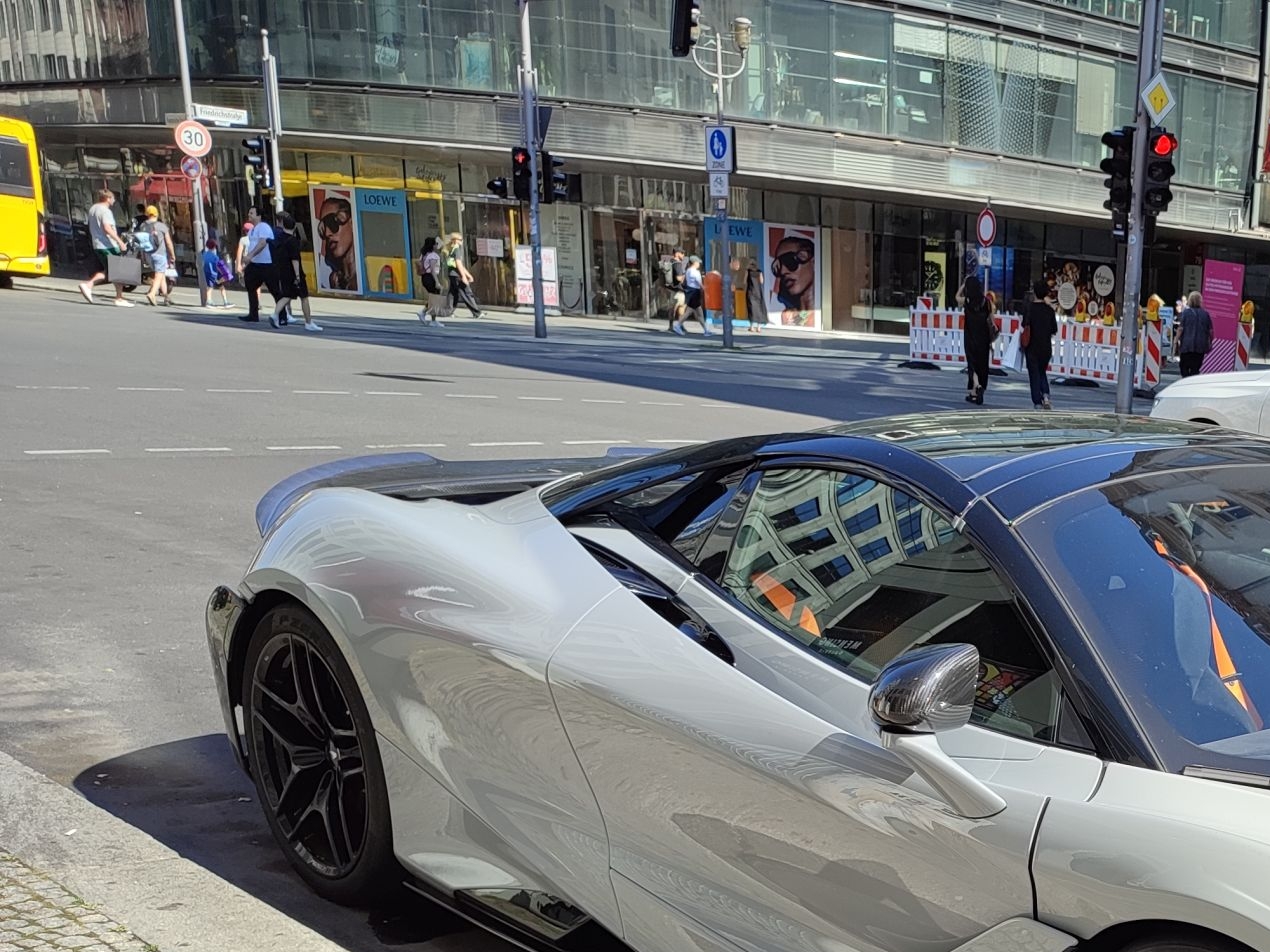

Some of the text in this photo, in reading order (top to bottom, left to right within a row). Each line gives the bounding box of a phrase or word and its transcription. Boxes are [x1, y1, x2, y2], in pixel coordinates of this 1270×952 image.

[183, 129, 204, 147] 30
[363, 194, 398, 207] LOEWE
[714, 223, 752, 237] LEWE
